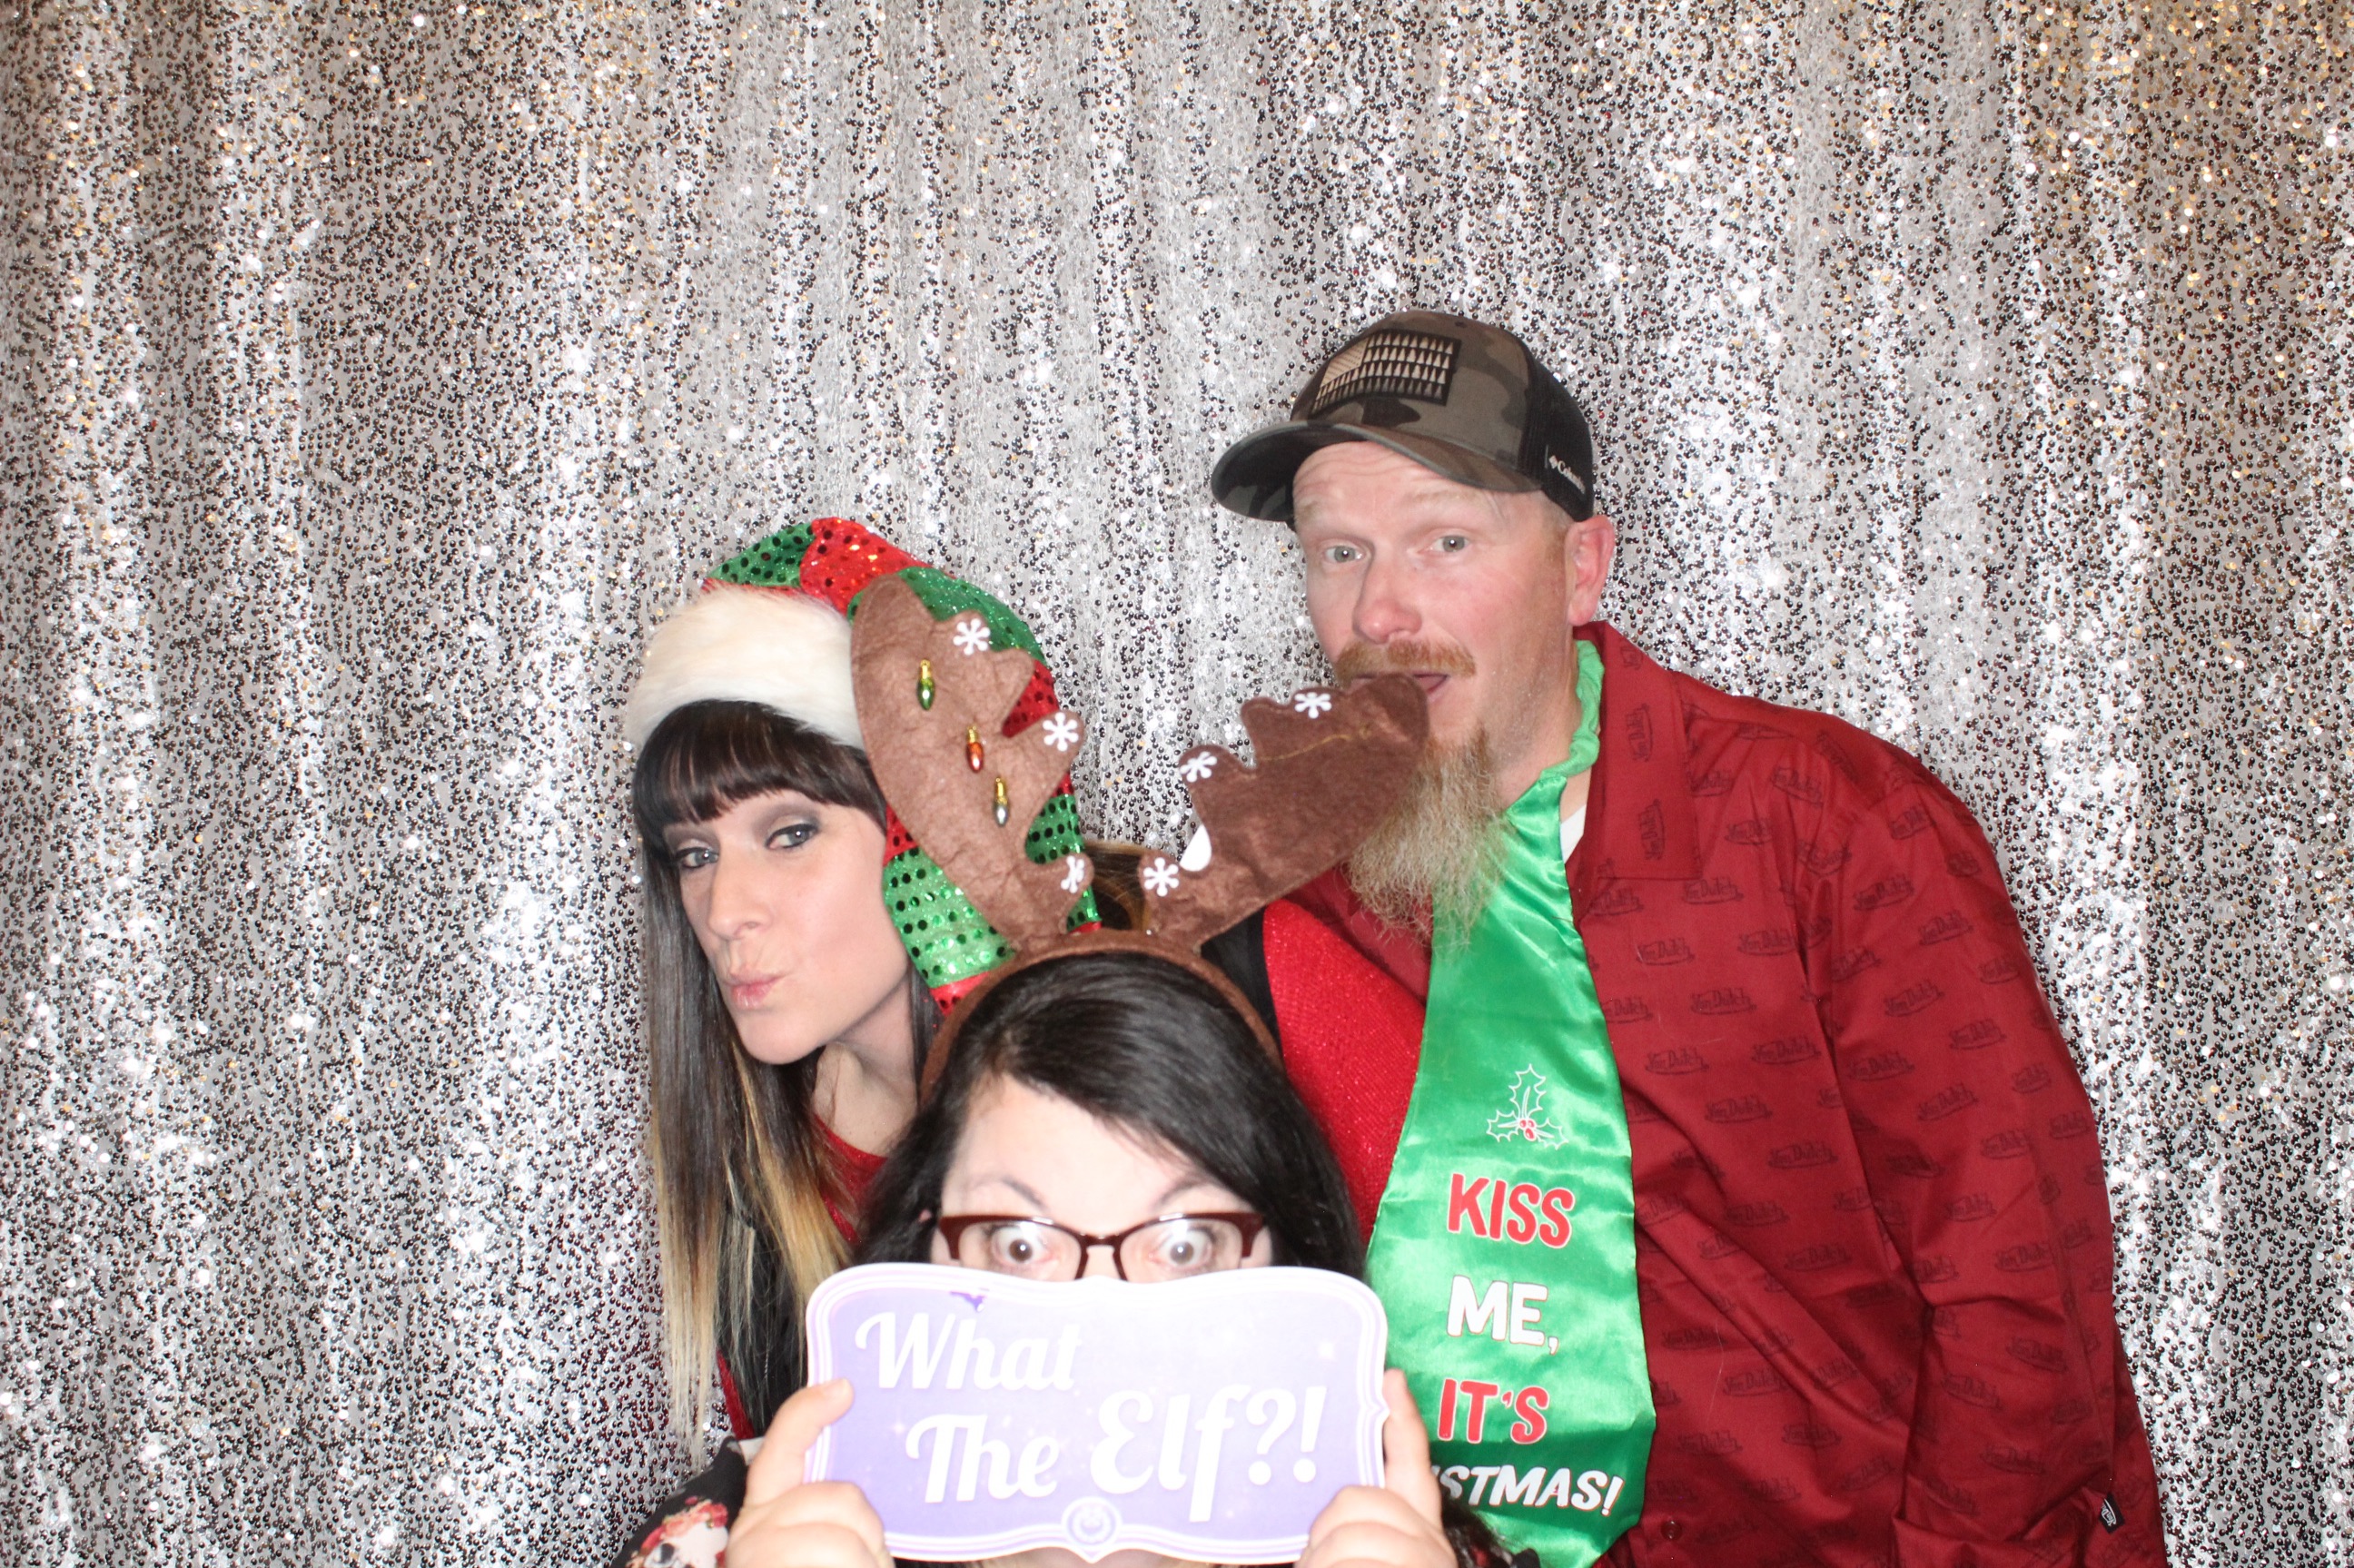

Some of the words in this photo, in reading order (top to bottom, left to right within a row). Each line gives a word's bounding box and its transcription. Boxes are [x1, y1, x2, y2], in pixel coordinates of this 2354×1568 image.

[1446, 1173, 1575, 1248] KISS
[855, 1311, 1082, 1391] What
[1446, 1275, 1559, 1356] ME,
[1438, 1379, 1549, 1445] IT'S
[905, 1414, 1060, 1504] The
[1090, 1384, 1328, 1523] Elf?!
